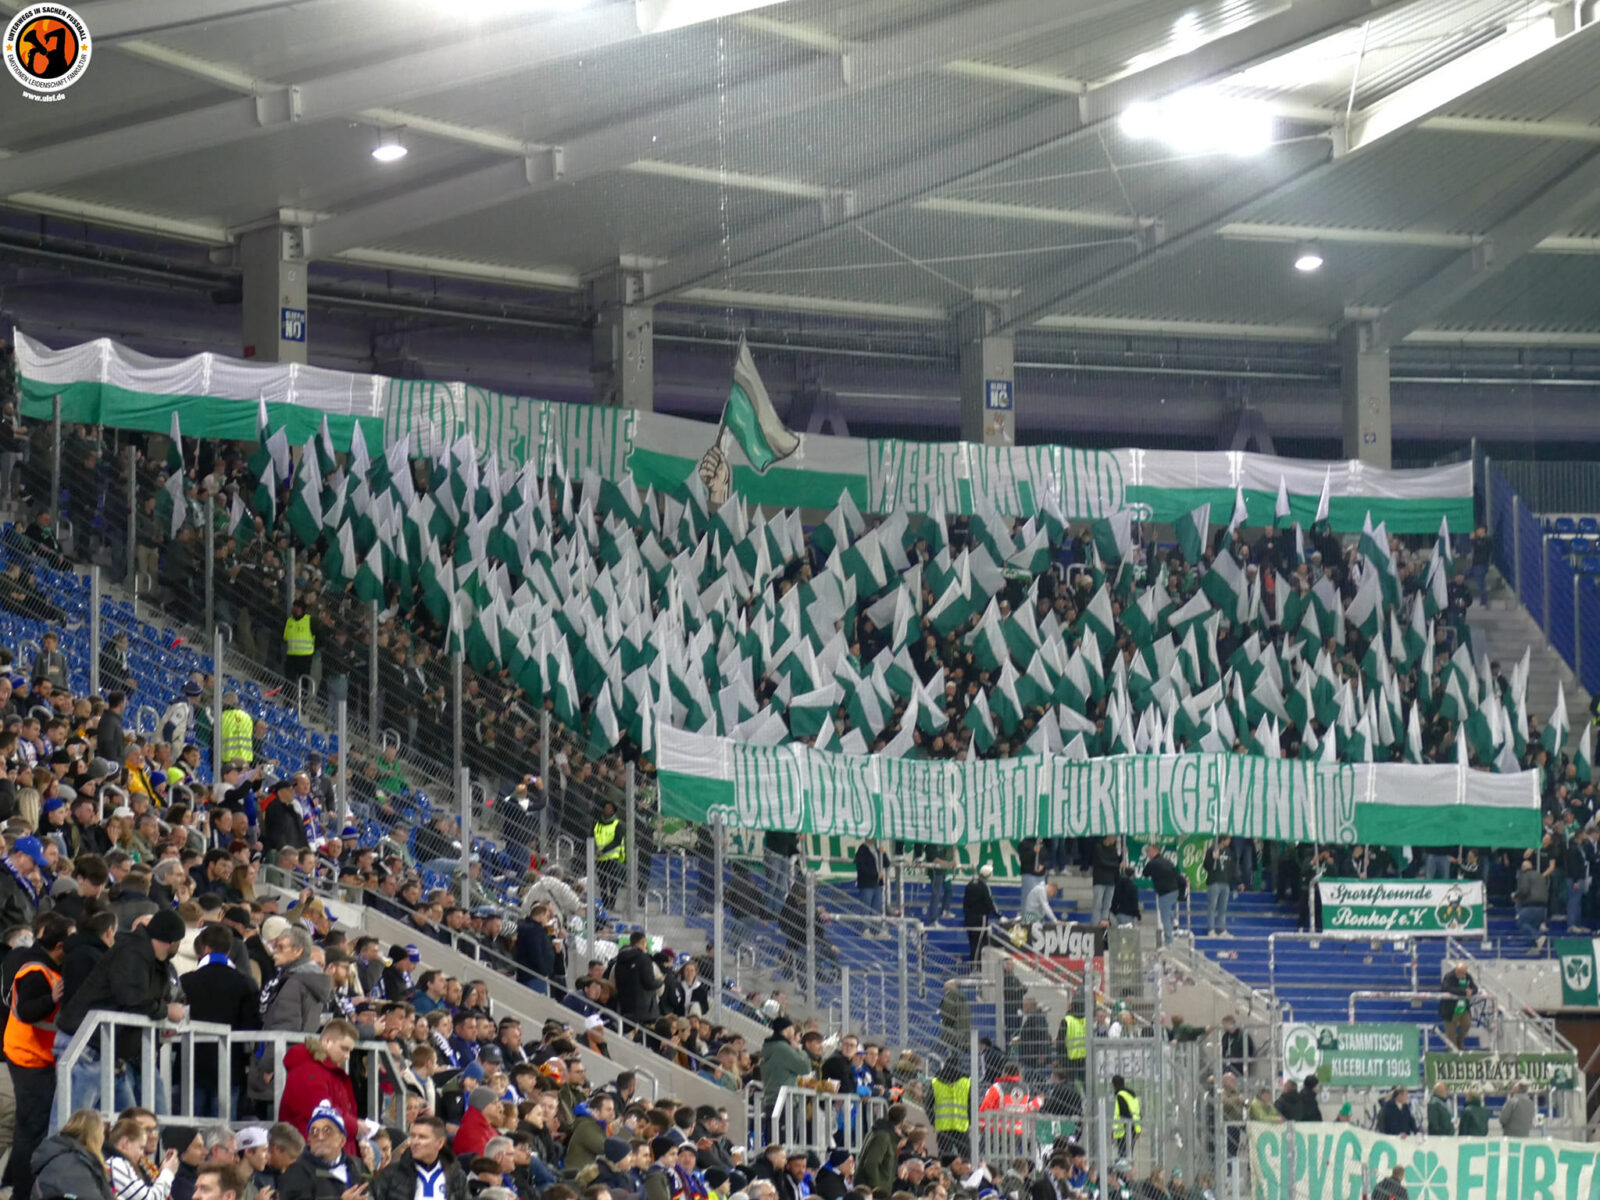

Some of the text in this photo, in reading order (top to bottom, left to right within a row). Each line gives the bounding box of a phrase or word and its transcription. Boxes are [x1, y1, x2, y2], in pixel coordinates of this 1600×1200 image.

[385, 379, 456, 459] UND
[464, 384, 521, 471] DIE
[528, 397, 635, 483] FAHNE
[867, 438, 961, 514] WEHT
[807, 746, 874, 837] DAS
[881, 754, 1043, 845] KLEEBLATT
[1172, 751, 1358, 845] GEWINNT!
[1331, 882, 1432, 904] Sportfreunde
[1332, 907, 1428, 930] Ronhof e.V.
[1031, 922, 1095, 960] SpVgg
[1338, 1033, 1403, 1052] STAMMTISCH
[1331, 1058, 1411, 1078] KLEEBLATT 1903
[1435, 1061, 1520, 1081] KLEEBLATT
[1456, 1141, 1600, 1200] FÜRT
